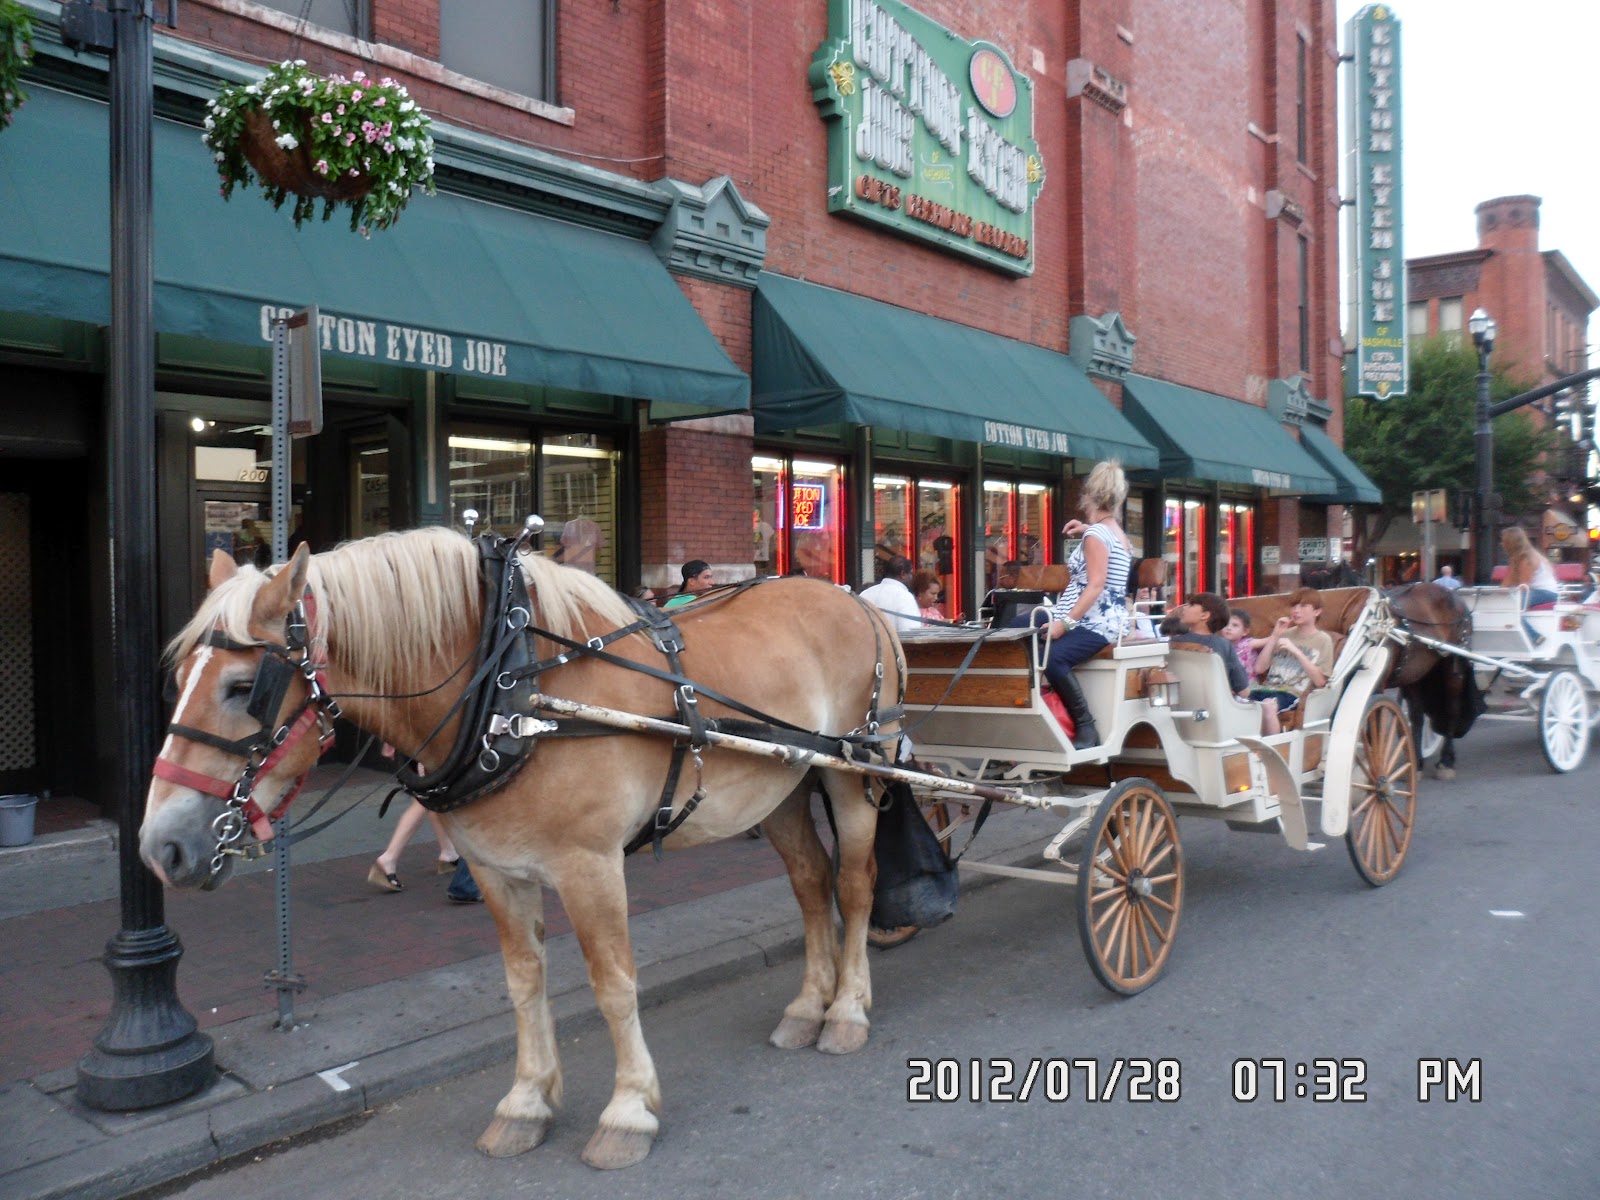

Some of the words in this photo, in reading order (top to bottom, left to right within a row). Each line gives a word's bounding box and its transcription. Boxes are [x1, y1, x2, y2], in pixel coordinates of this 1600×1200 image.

[853, 0, 962, 157] COTTON
[967, 107, 1027, 214] EYED
[856, 77, 915, 179] JOE
[1371, 257, 1394, 323] JOE
[260, 304, 376, 357] CTON
[386, 325, 452, 368] EYED
[462, 339, 507, 377] JOE
[985, 420, 1024, 447] COTTON
[1025, 427, 1050, 451] EYED
[1052, 432, 1069, 454] JOE
[240, 469, 266, 482] 200
[793, 487, 820, 501] TTON
